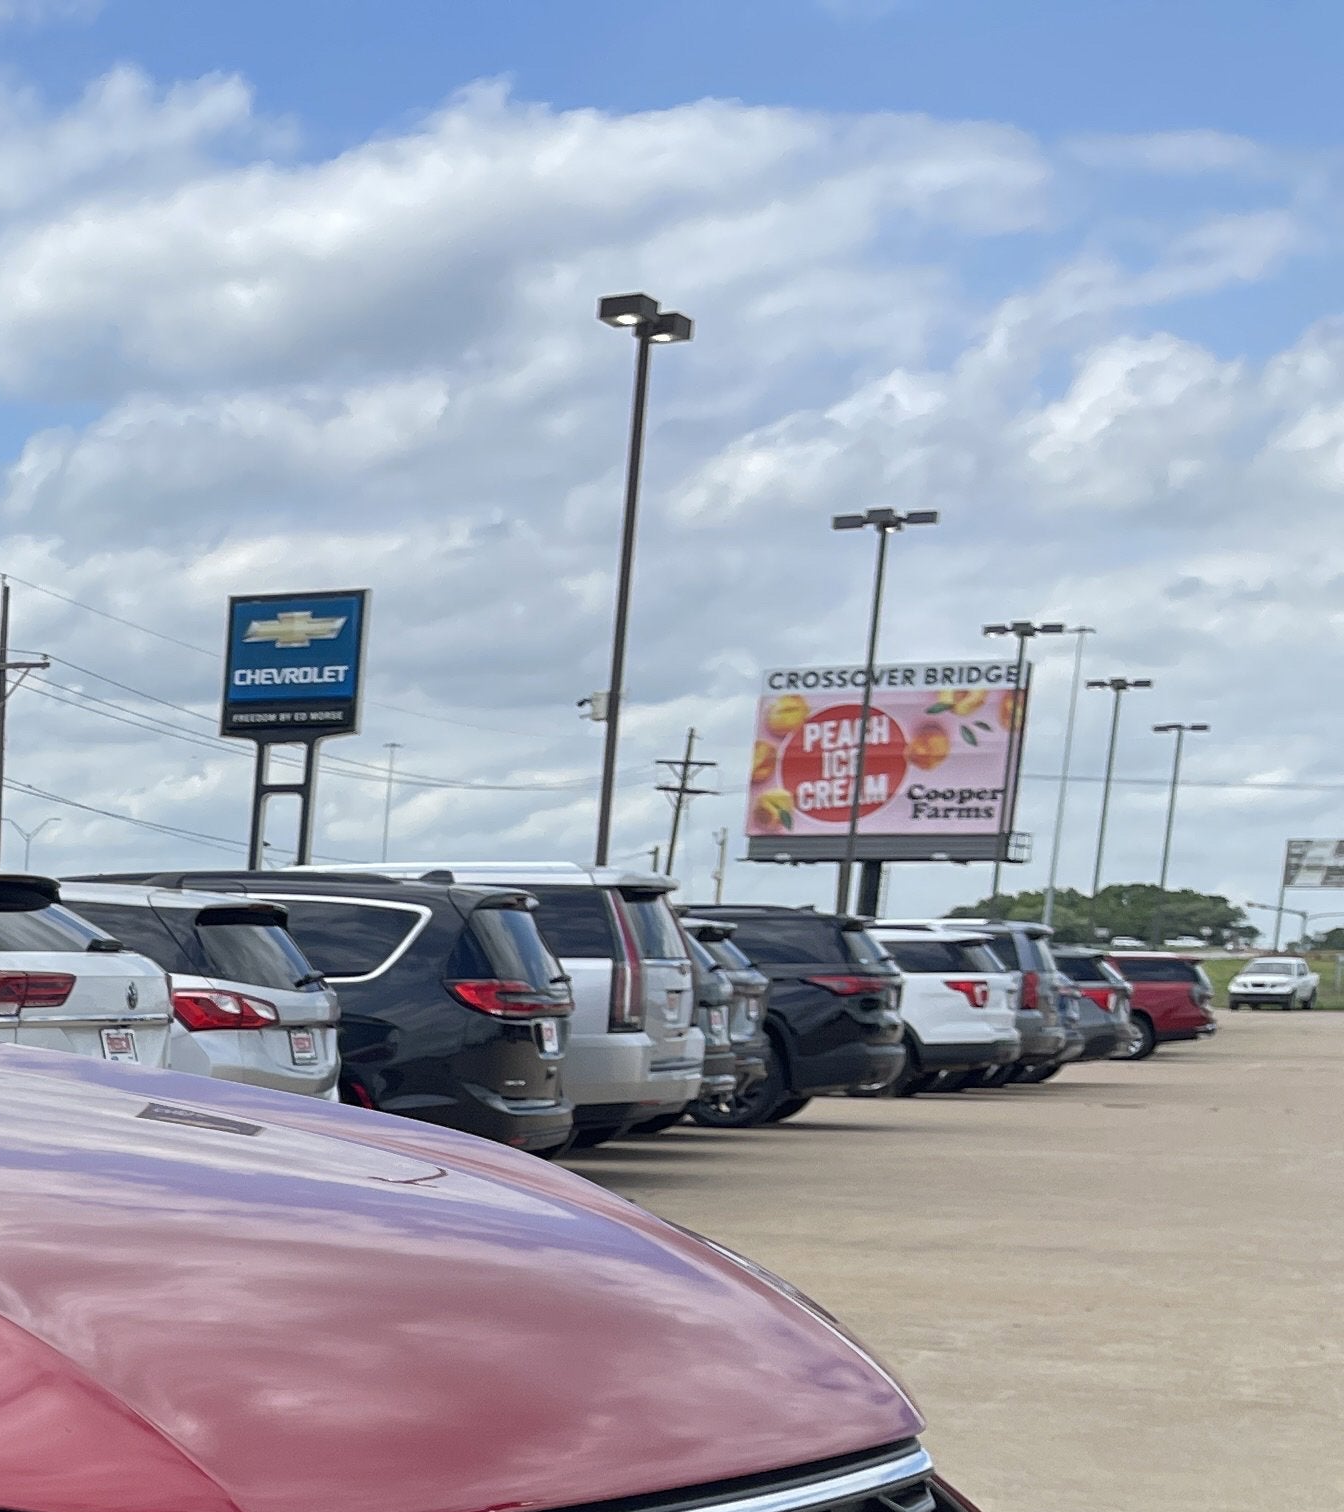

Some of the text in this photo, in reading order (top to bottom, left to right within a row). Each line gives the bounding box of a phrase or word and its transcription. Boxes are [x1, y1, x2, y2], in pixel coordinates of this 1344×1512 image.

[234, 665, 348, 685] CHEVROLET
[768, 665, 1019, 690] CROSSOVER BRIDGE
[907, 784, 1005, 804] Cooper
[911, 803, 994, 820] Farms
